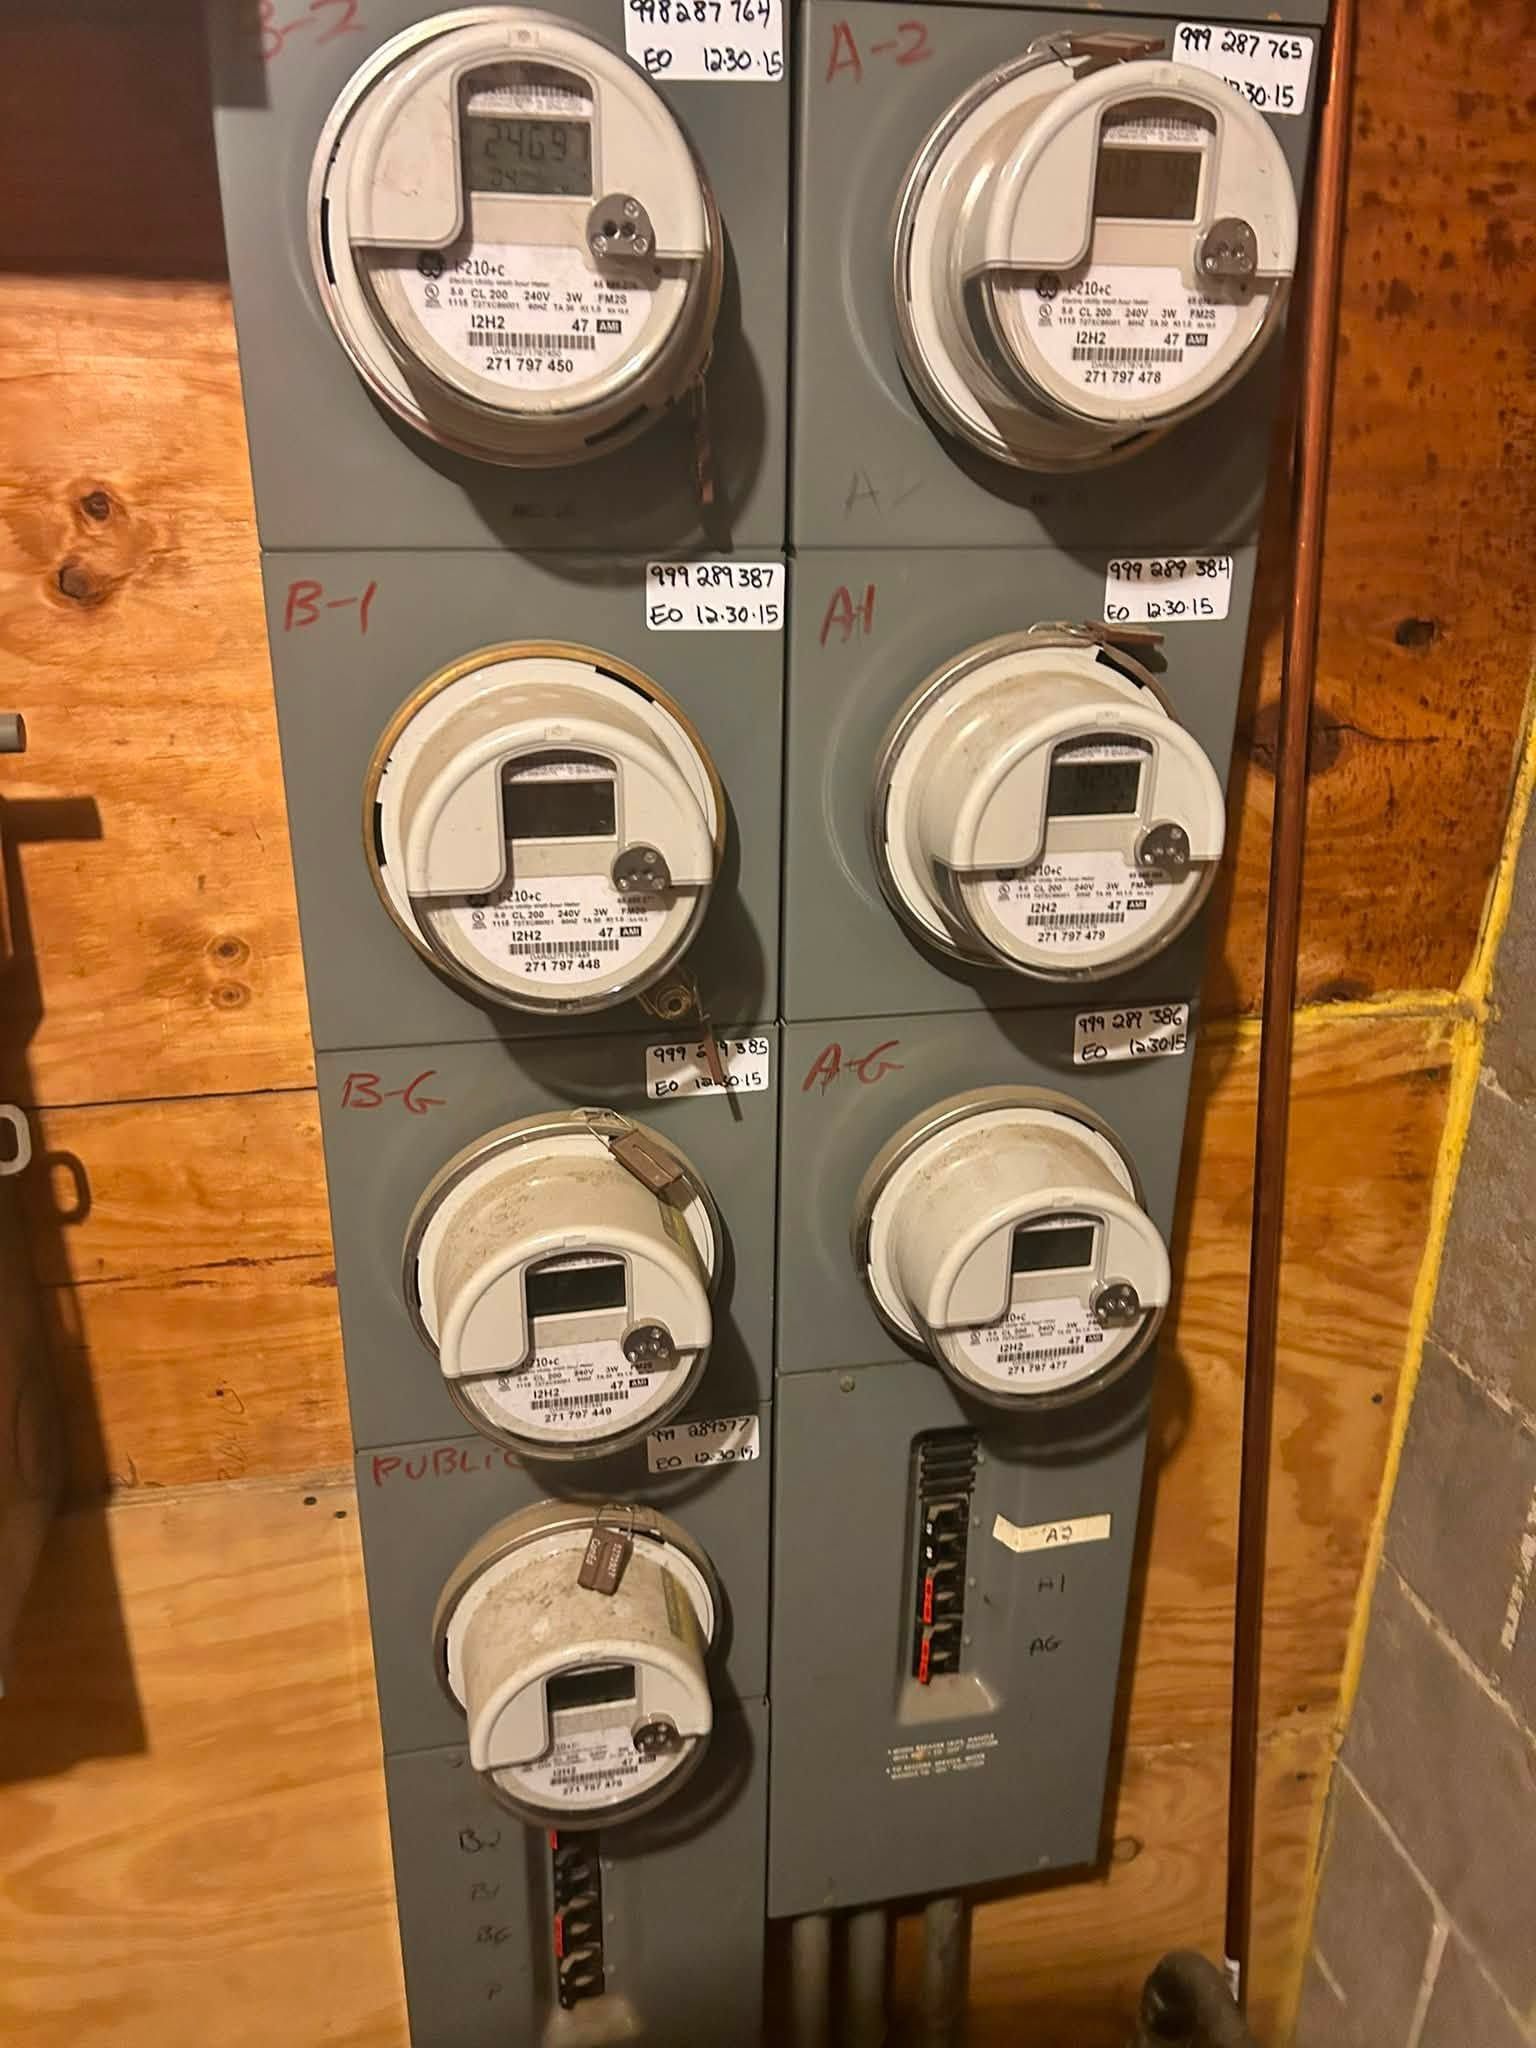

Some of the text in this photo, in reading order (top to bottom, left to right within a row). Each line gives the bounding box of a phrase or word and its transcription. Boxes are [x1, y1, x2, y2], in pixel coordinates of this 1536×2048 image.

[1180, 27, 1303, 59] 999 287 765
[825, 20, 936, 85] A-2
[489, 289, 509, 300] 200
[524, 291, 551, 302] 240V
[566, 292, 583, 303] 3W
[1125, 308, 1149, 319] 240V
[571, 318, 589, 333] 47
[1163, 333, 1180, 346] 47
[486, 357, 575, 374] 271 797 450
[1084, 370, 1162, 385] 271 797 478
[1109, 556, 1230, 581] 999 289 384
[651, 565, 774, 589] 999 289 387
[284, 580, 378, 636] B-1
[649, 604, 684, 627] EO
[1107, 900, 1122, 911] 47
[528, 910, 545, 920] 200
[557, 909, 580, 919] 240V
[593, 908, 609, 917] 3W
[598, 927, 614, 938] 47
[1037, 929, 1106, 943] 271 797 479
[525, 958, 601, 973] 271 797 448
[1078, 1006, 1182, 1033] 999 289 386
[653, 1046, 687, 1063] 999
[735, 1039, 769, 1055] 385
[1007, 1365, 1025, 1376] 271
[610, 1380, 624, 1391] 47
[544, 1412, 564, 1423] 271
